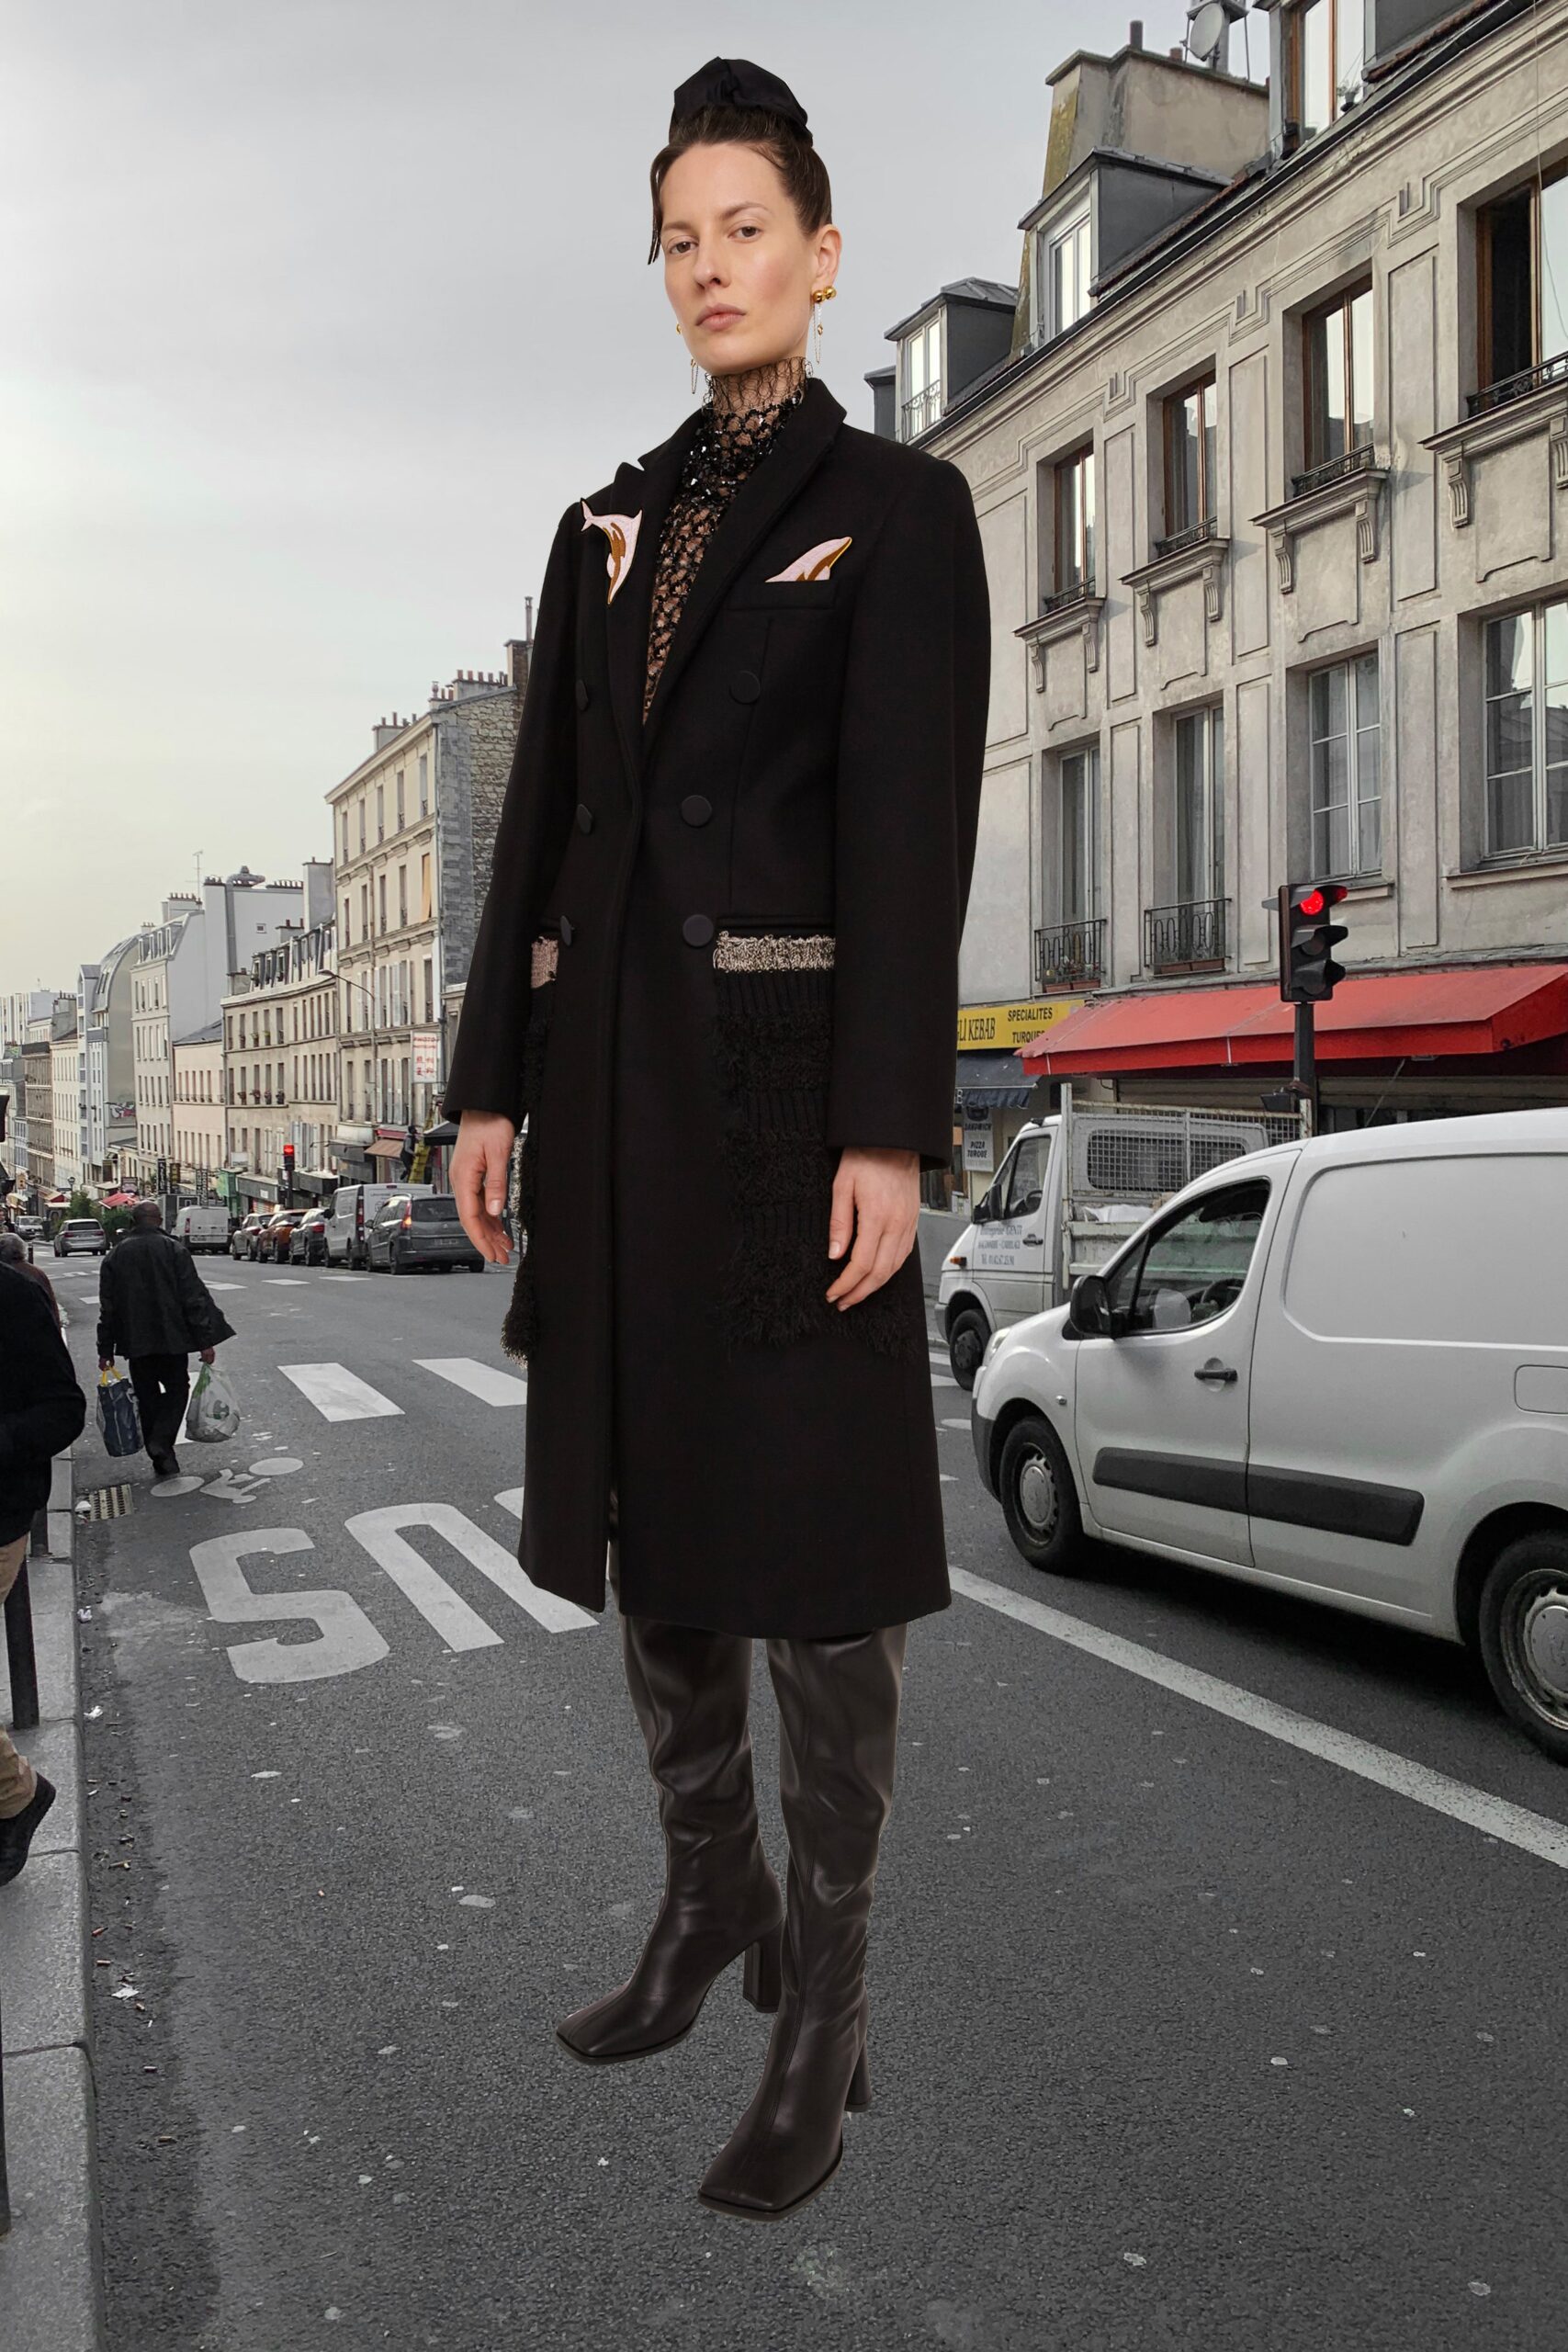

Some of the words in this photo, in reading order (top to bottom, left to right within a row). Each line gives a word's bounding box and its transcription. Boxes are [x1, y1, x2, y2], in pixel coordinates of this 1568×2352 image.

[1008, 1007, 1053, 1022] SPECIALITES
[968, 1017, 996, 1041] KEBAB
[970, 1140, 985, 1149] PIZZA
[189, 1487, 600, 1683] US
